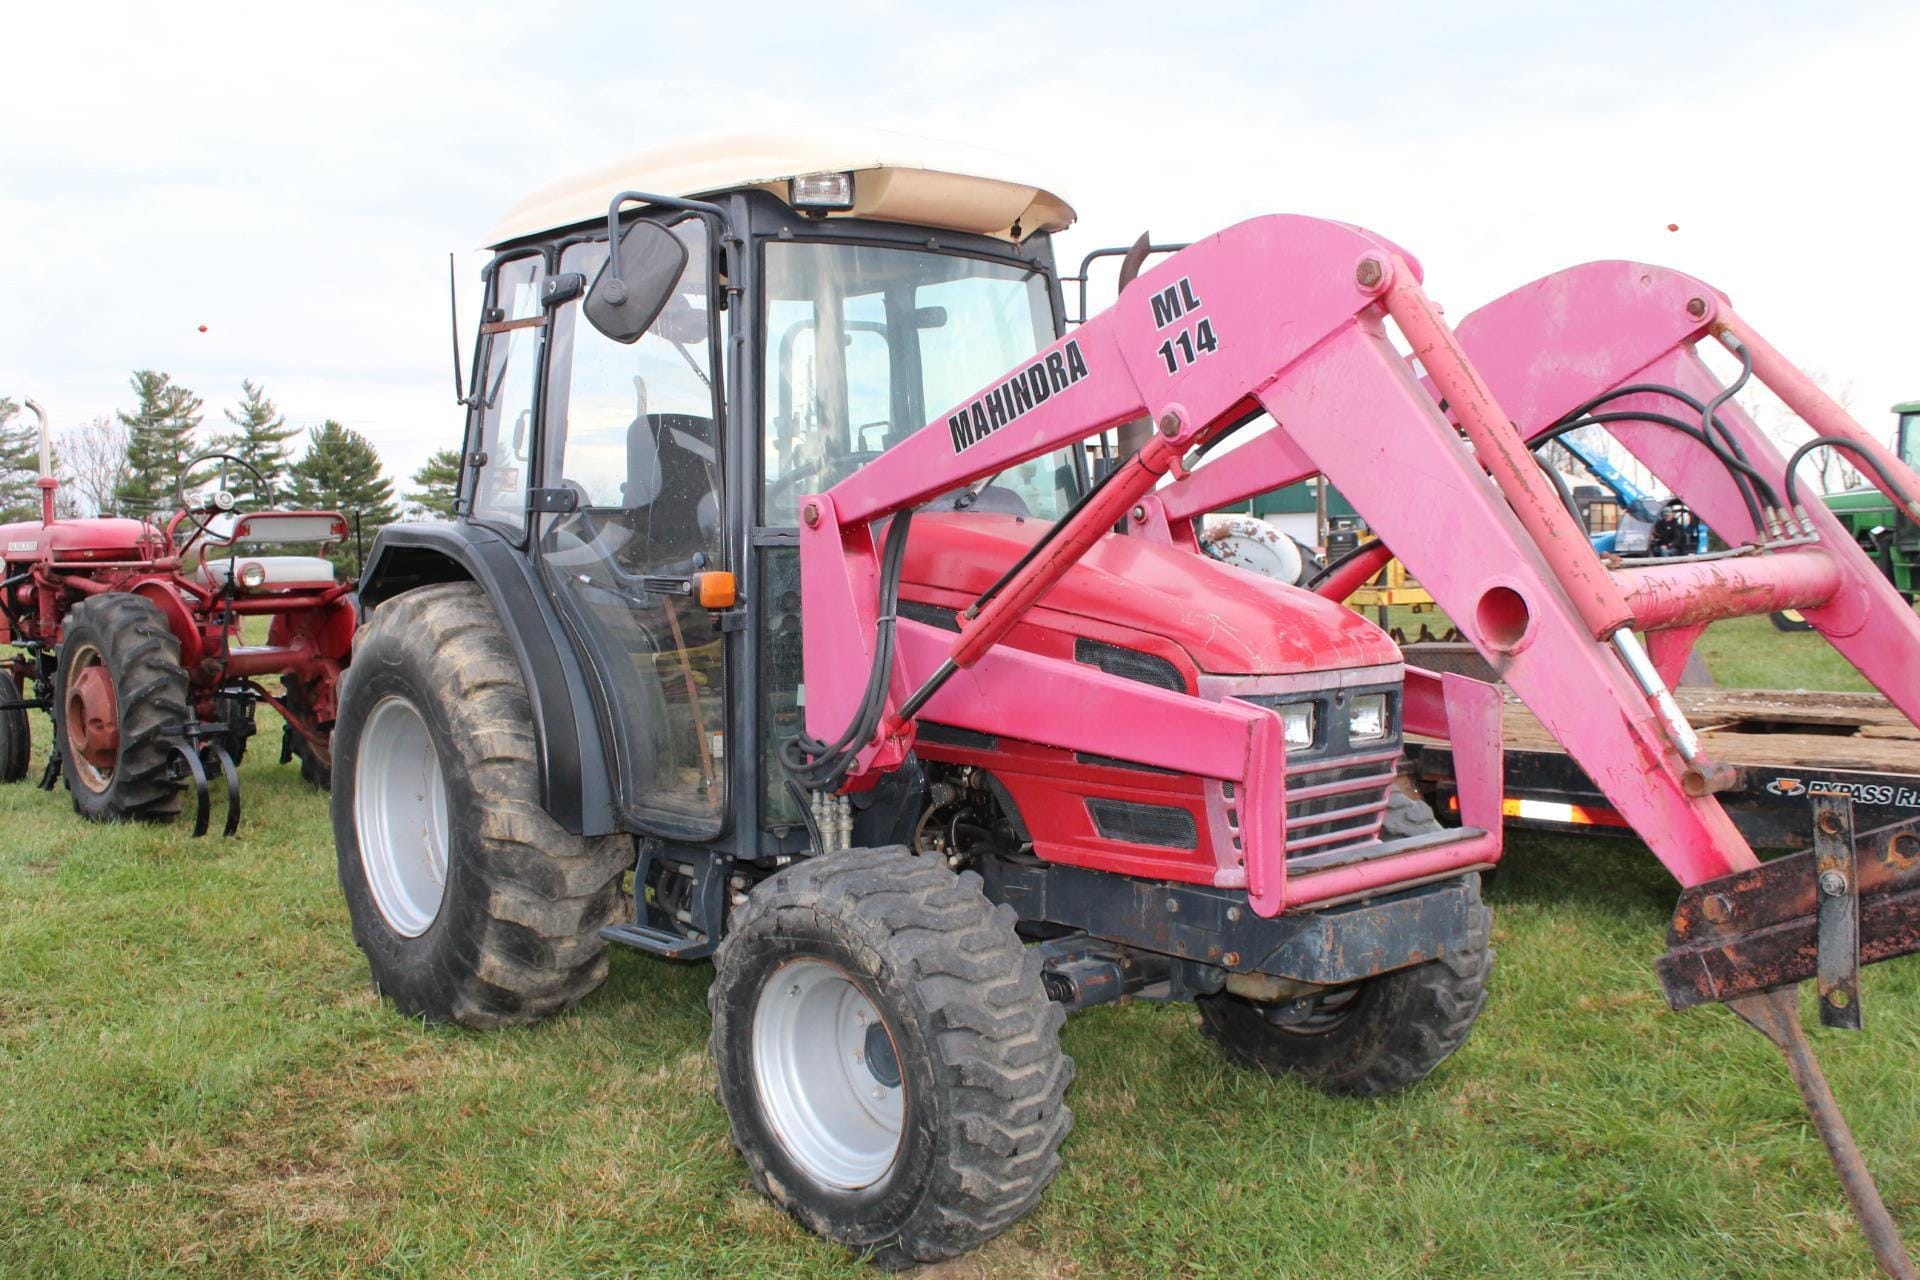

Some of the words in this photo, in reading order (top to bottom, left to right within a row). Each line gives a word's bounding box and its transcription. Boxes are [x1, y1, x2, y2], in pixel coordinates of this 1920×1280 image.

[1150, 277, 1201, 330] ML
[1158, 317, 1217, 374] 114
[949, 340, 1088, 453] MAHINDRA
